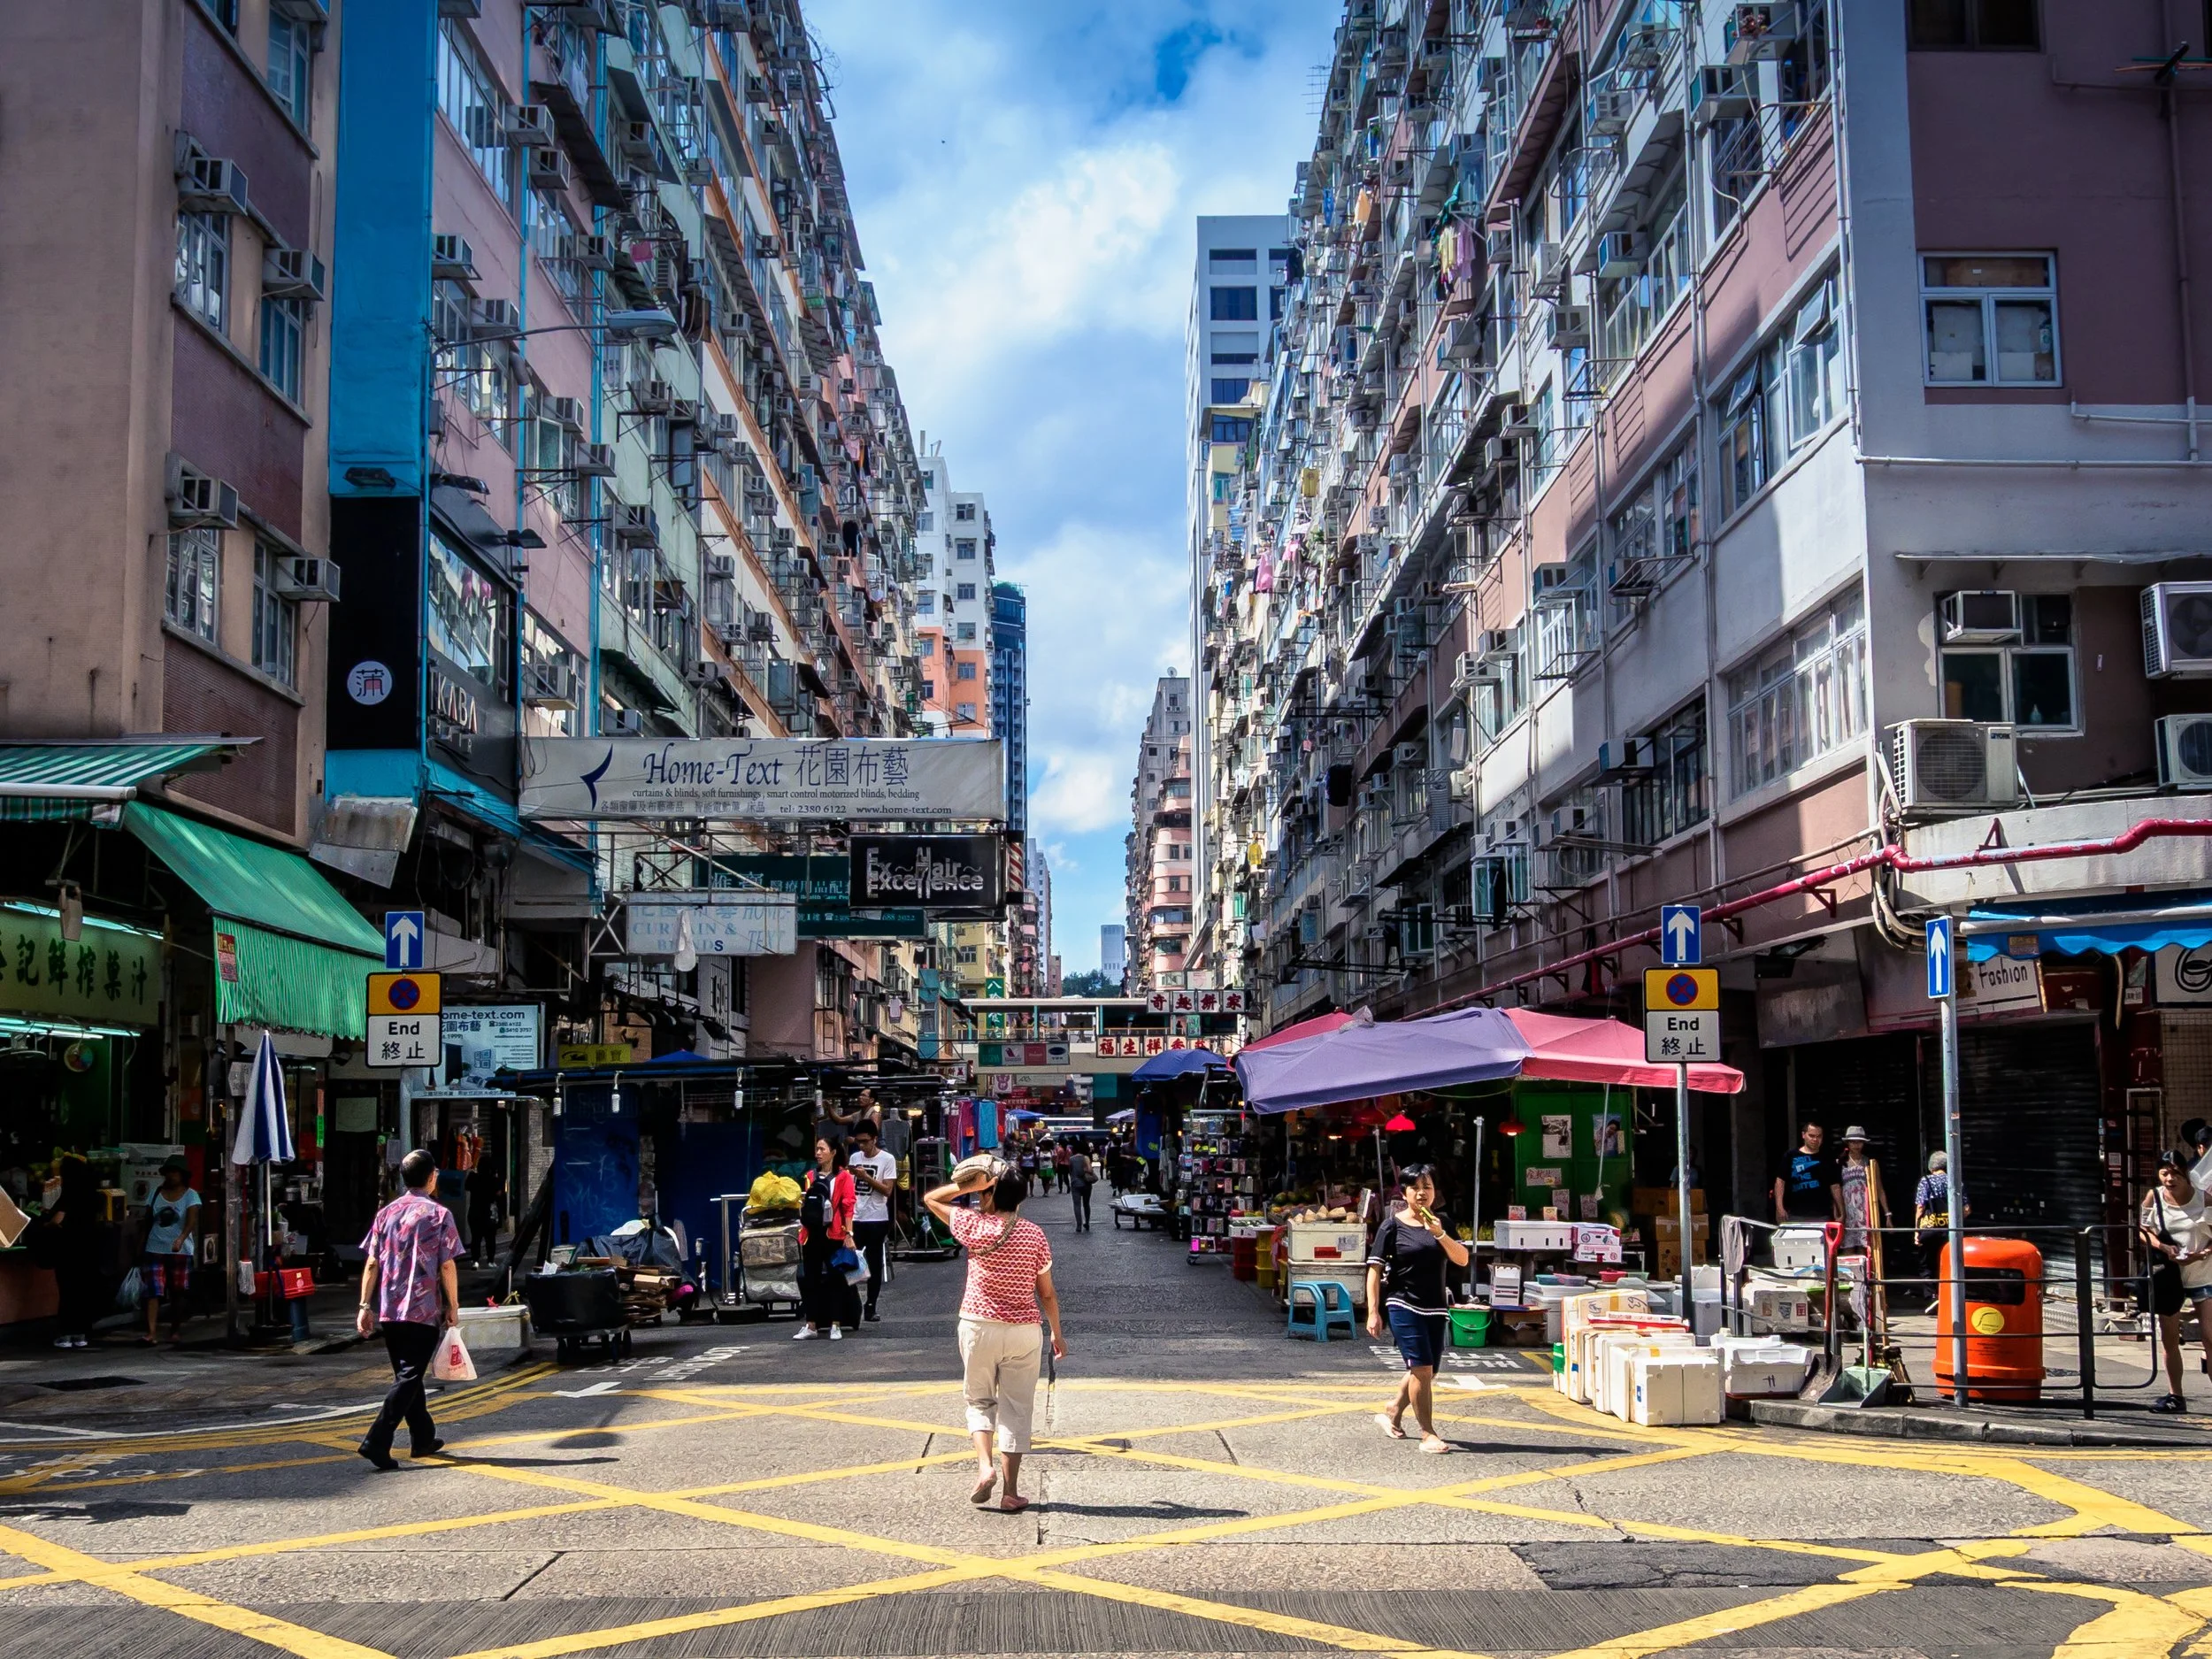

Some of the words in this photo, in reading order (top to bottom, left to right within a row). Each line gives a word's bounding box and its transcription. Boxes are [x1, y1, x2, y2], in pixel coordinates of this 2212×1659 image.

[643, 742, 784, 785] Home-Text
[795, 745, 909, 787] 花園布藝
[632, 787, 664, 798] curtains
[664, 788, 672, 797] &
[674, 787, 700, 799] blinds,
[702, 787, 716, 798] soft
[789, 788, 818, 798] control
[819, 788, 859, 798] motorized
[860, 788, 886, 799] blinds,
[887, 788, 920, 801] bedding
[797, 805, 822, 814] 2380
[823, 805, 847, 814] 6122
[856, 805, 952, 814] www.home-text.com
[1977, 956, 2028, 988] Fashion
[1149, 993, 1242, 1011] 奇趣餅家
[442, 1010, 526, 1019] ome-text.com
[388, 1021, 420, 1035] End
[1667, 1017, 1700, 1031] End
[381, 1041, 426, 1060] 終止
[1661, 1036, 1707, 1056] 終止
